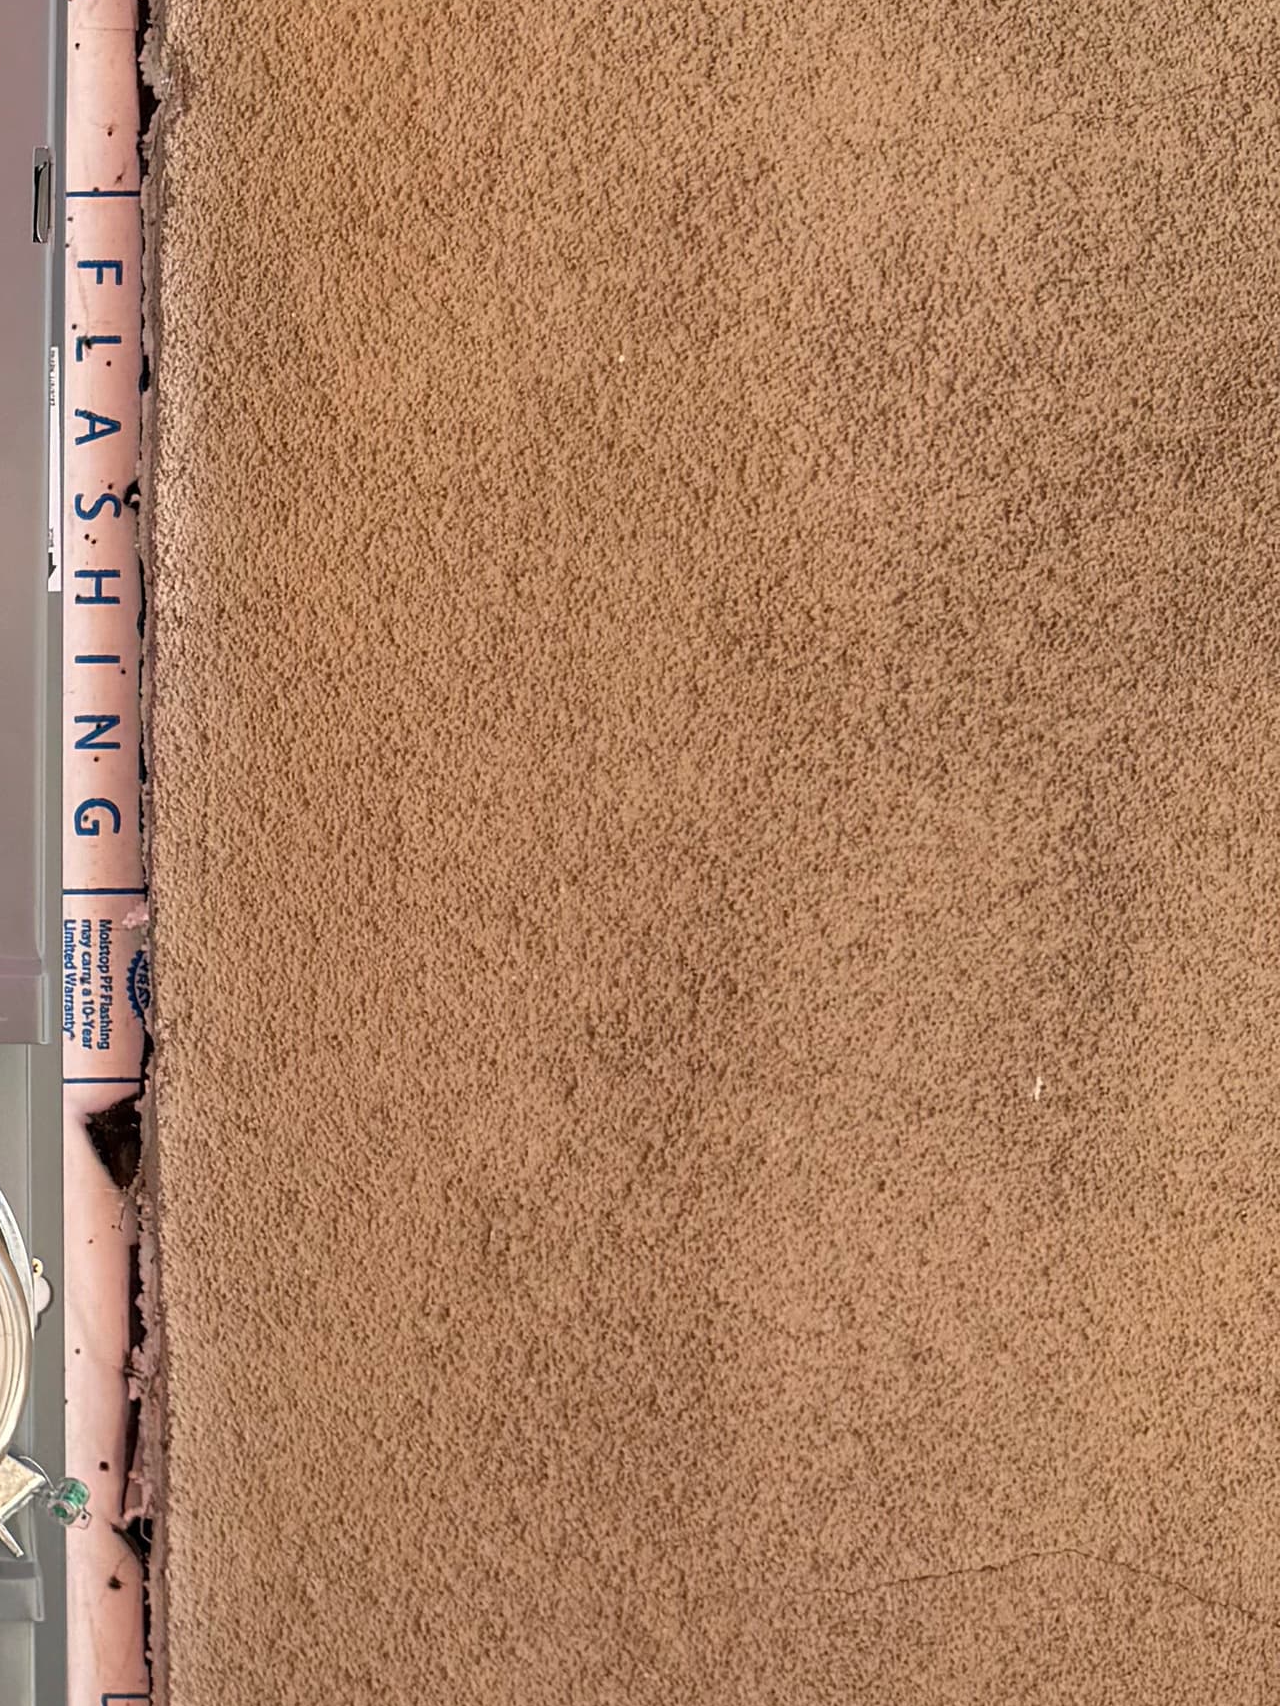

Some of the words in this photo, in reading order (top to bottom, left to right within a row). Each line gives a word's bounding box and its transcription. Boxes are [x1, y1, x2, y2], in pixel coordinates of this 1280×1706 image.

[73, 259, 124, 837] FLASHING
[64, 919, 77, 970] Limited
[80, 919, 93, 948] may
[97, 918, 113, 974] Moistop
[82, 988, 93, 997] a
[99, 975, 113, 993] PF
[81, 999, 95, 1050] 10-Year
[97, 994, 113, 1050] Flashing
